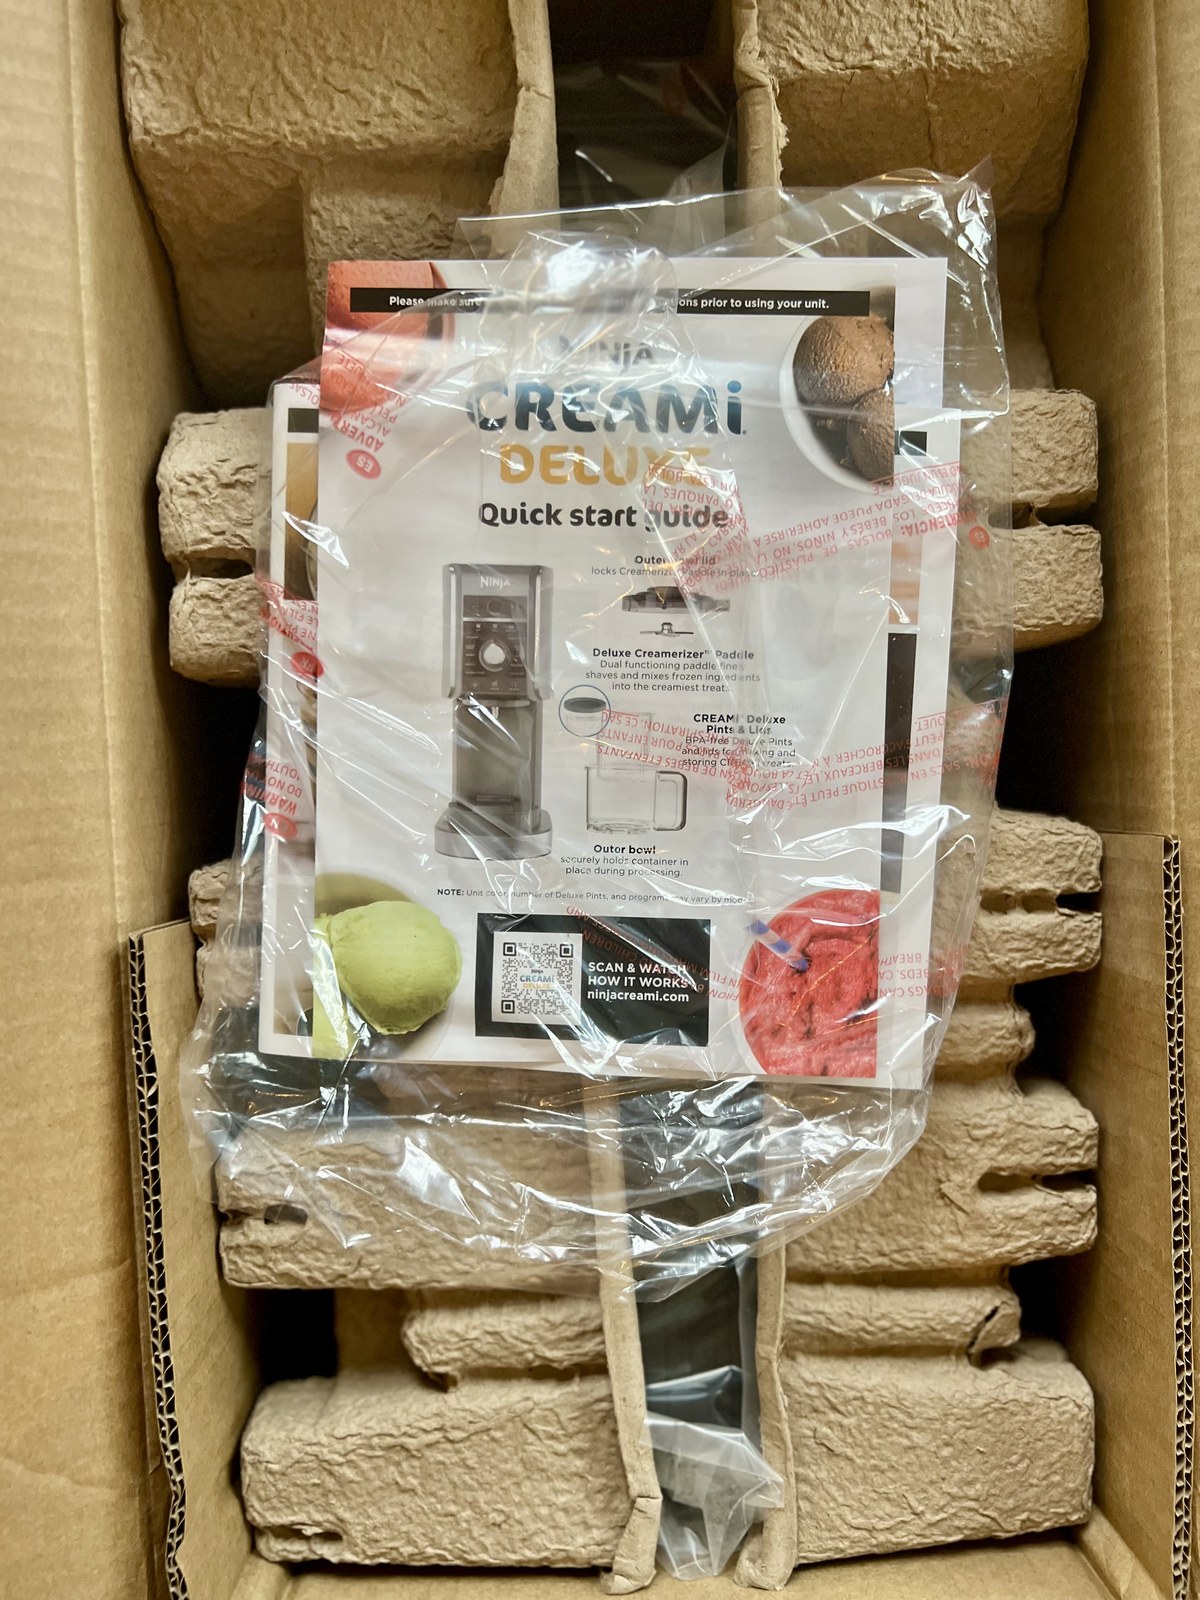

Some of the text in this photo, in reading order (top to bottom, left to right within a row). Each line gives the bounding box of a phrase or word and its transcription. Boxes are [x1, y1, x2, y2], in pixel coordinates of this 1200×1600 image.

[389, 296, 424, 306] Please
[701, 297, 727, 309] prior
[730, 298, 742, 308] to
[744, 298, 774, 310] using
[777, 299, 802, 310] your
[804, 298, 830, 309] unit.
[479, 502, 563, 527] Quick
[569, 504, 637, 527] start
[644, 504, 729, 532] guide
[834, 502, 873, 522] PUEDE
[893, 509, 915, 523] LOS
[764, 515, 829, 546] ADHERIRSE
[842, 527, 848, 538] Y
[753, 537, 761, 547] A
[847, 528, 892, 550] BOLSAS
[774, 546, 790, 559] NO
[823, 544, 838, 559] DE
[635, 555, 667, 565] Oute
[753, 552, 767, 565] LA
[591, 567, 616, 576] locks
[480, 576, 511, 589] NINJA
[593, 648, 631, 658] Deluxe
[600, 660, 622, 669] Dual
[625, 660, 680, 671] functioning
[683, 661, 717, 672] paddle
[585, 671, 618, 680] shaves
[621, 671, 639, 680] and
[642, 672, 669, 680] mixes
[672, 672, 701, 681] frozen
[612, 683, 630, 691] into
[633, 683, 649, 691] the
[652, 683, 699, 692] creamiest
[625, 716, 639, 727] CE
[747, 714, 786, 724] Deluxe
[914, 714, 945, 732] OUET.
[738, 726, 745, 734] &
[599, 728, 648, 746] ENFANTS
[732, 737, 766, 746] Delue
[915, 733, 943, 747] PEUT
[651, 737, 682, 753] POUR
[682, 747, 699, 755] and
[777, 749, 796, 757] and
[909, 749, 941, 764] DANS
[683, 758, 710, 768] storing
[266, 759, 301, 781] OUTH
[820, 761, 883, 783] BERCEAUX.
[911, 768, 927, 781] EN
[843, 772, 905, 796] STIQUE
[287, 784, 303, 798] DO
[812, 786, 839, 802] PEUT
[594, 844, 656, 854] Outer bowl
[561, 856, 600, 865] securely
[631, 857, 677, 866] container
[680, 857, 689, 866] in
[566, 866, 591, 875] place
[594, 866, 625, 876] during
[437, 888, 465, 896] NOTE:
[467, 889, 484, 897] Unit
[511, 890, 542, 898] numer
[545, 890, 553, 898] of
[556, 891, 584, 899] Deluxe
[586, 892, 609, 901] Pints,
[611, 892, 627, 900] and
[711, 895, 721, 904] by
[588, 961, 624, 974] SCAN
[627, 962, 636, 974] &
[639, 963, 687, 975] WATCH
[588, 976, 689, 989] HOW IT WORKS
[587, 989, 689, 1003] ninjacreami.com
